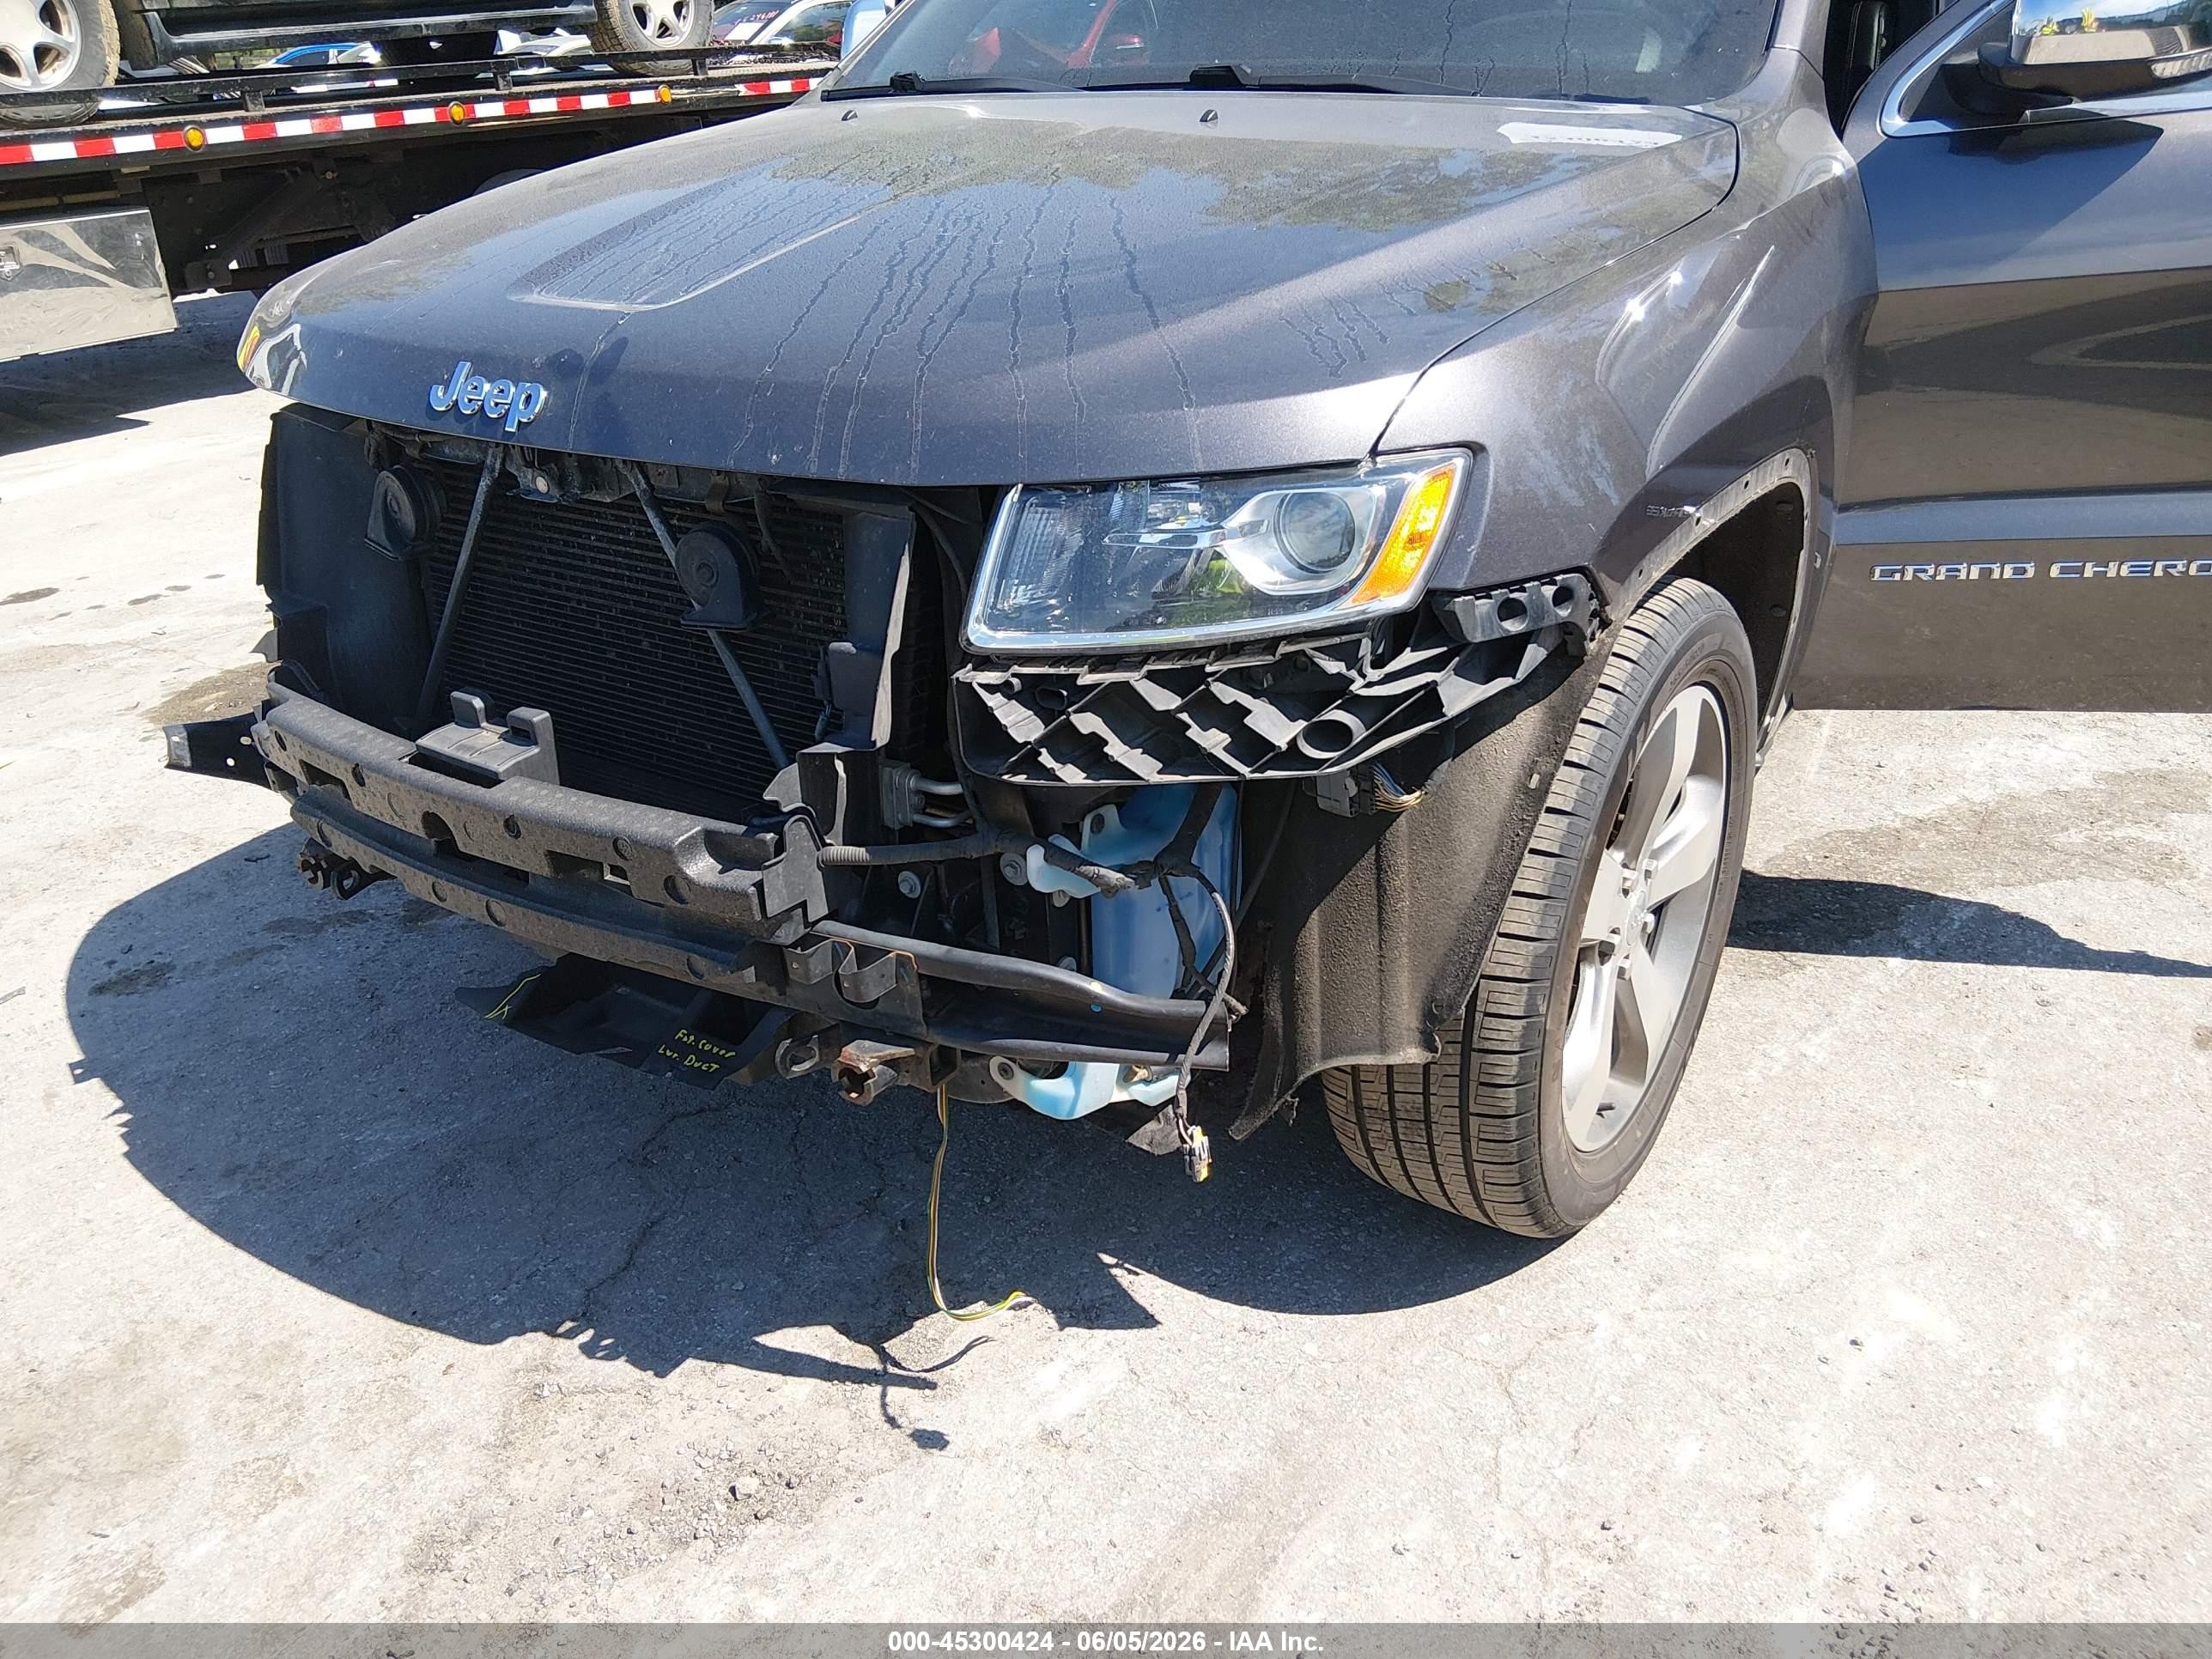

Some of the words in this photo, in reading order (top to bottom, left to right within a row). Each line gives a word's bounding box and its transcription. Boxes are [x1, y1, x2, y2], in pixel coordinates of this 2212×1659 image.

[430, 361, 548, 432] Jeep
[1870, 562, 2035, 580] GRAND
[2050, 559, 2212, 579] CHERO
